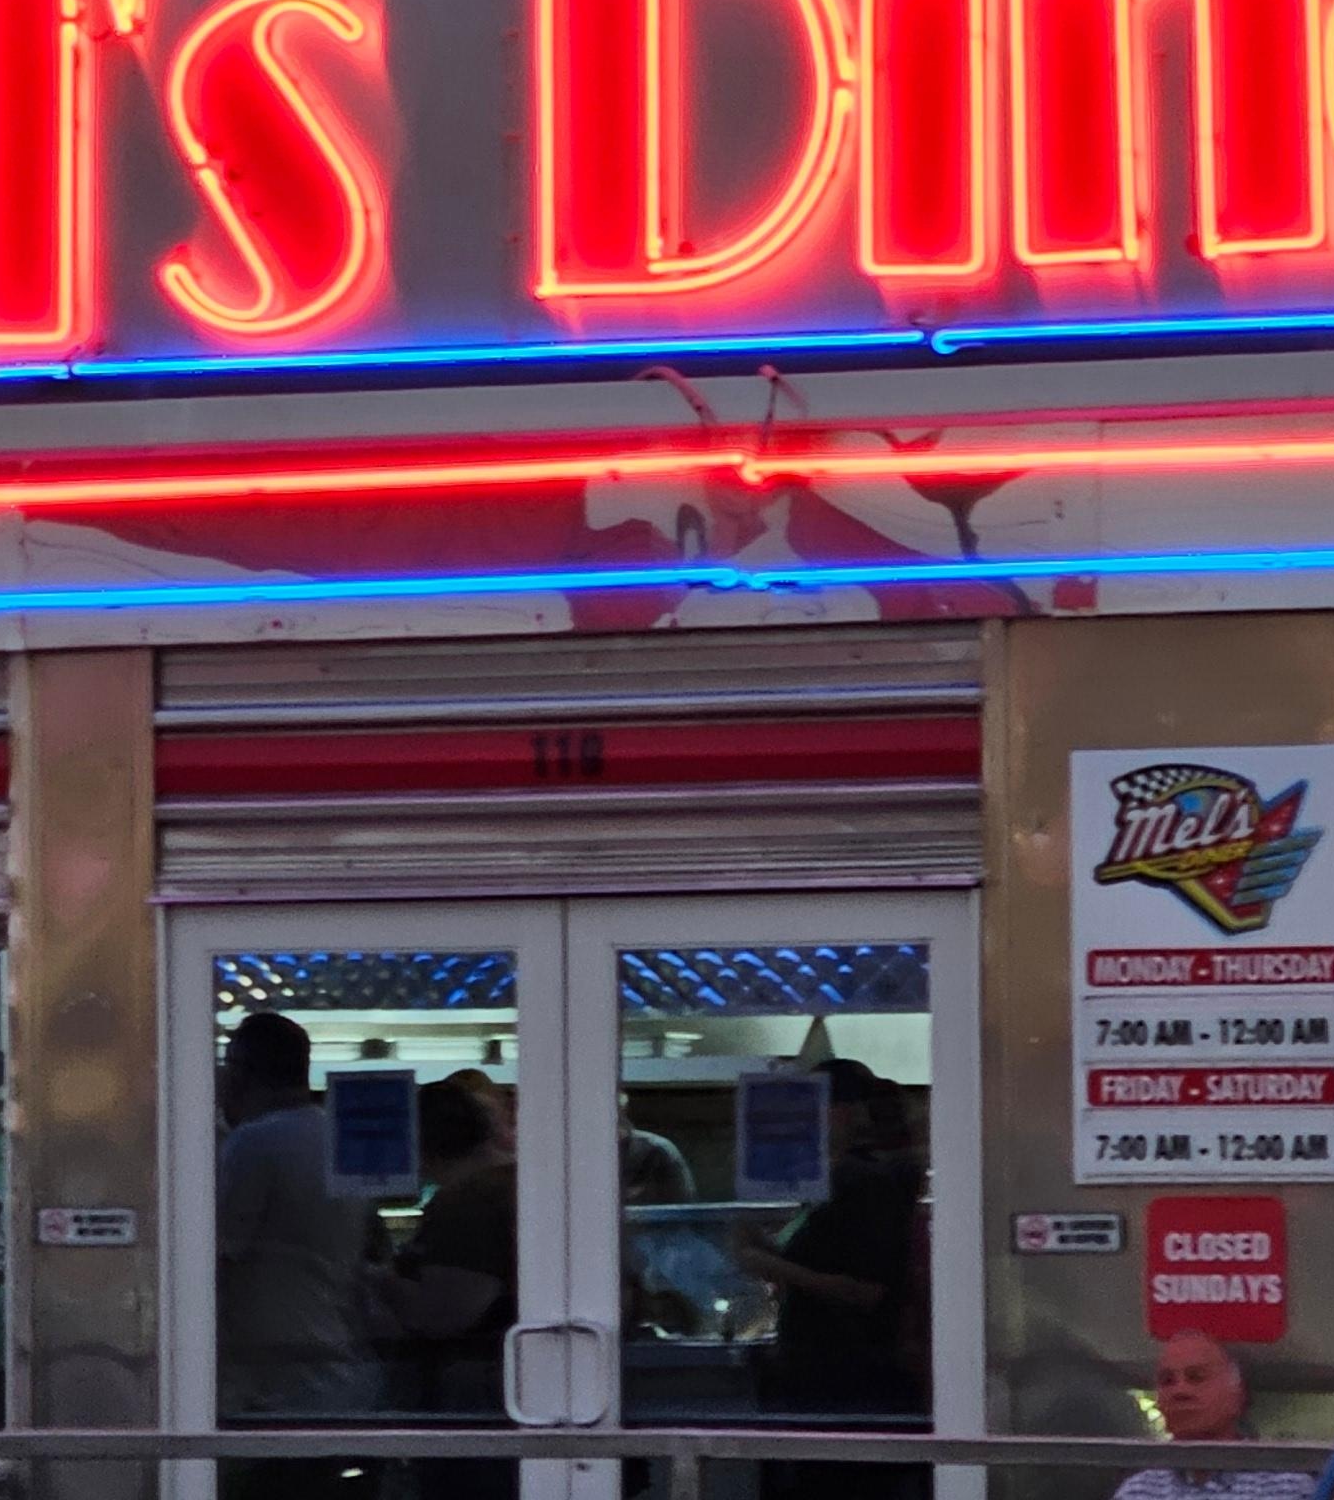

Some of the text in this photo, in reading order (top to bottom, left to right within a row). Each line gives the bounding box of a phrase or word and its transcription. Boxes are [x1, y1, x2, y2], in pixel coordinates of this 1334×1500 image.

[1115, 788, 1256, 862] Mel's
[1094, 956, 1194, 983] MONDAY
[1212, 953, 1334, 981] THURSDAY
[1095, 1018, 1148, 1046] 7:00
[1155, 1018, 1193, 1045] AM
[1218, 1017, 1285, 1045] 12:00
[1291, 1017, 1329, 1044] AM
[1100, 1074, 1185, 1102] FRIDAY
[1206, 1072, 1329, 1101] SATURDAY
[1095, 1134, 1148, 1161] 7:00
[1154, 1134, 1192, 1161] AM
[1218, 1133, 1285, 1161] 12:00
[1291, 1133, 1329, 1160] AM
[1164, 1232, 1271, 1262] CLOSED
[1152, 1273, 1283, 1303] SUNDAYS
